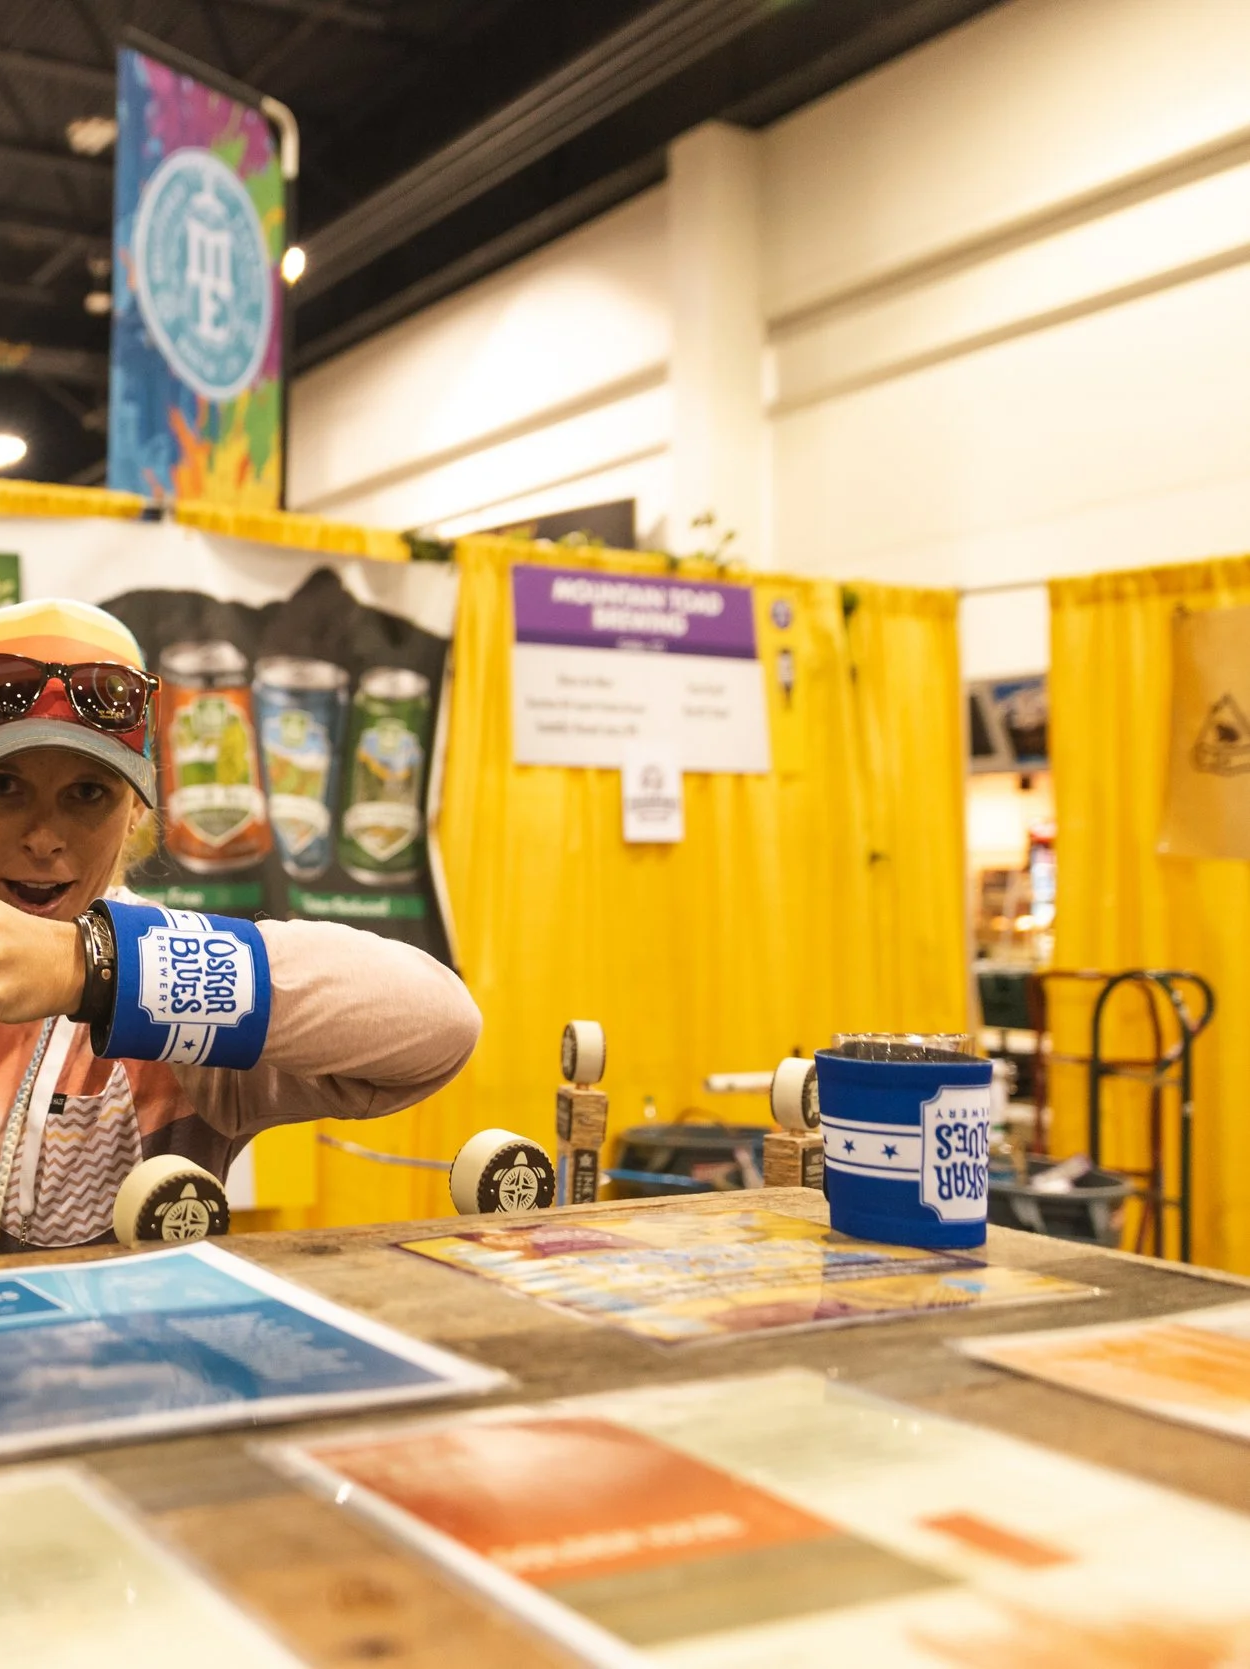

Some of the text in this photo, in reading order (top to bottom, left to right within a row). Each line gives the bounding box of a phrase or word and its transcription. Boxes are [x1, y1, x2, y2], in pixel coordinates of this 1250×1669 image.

[156, 935, 168, 1014] BREWERY
[168, 936, 203, 1015] BLUES
[203, 938, 238, 1016] OSKAR
[933, 1161, 989, 1201] SKAR
